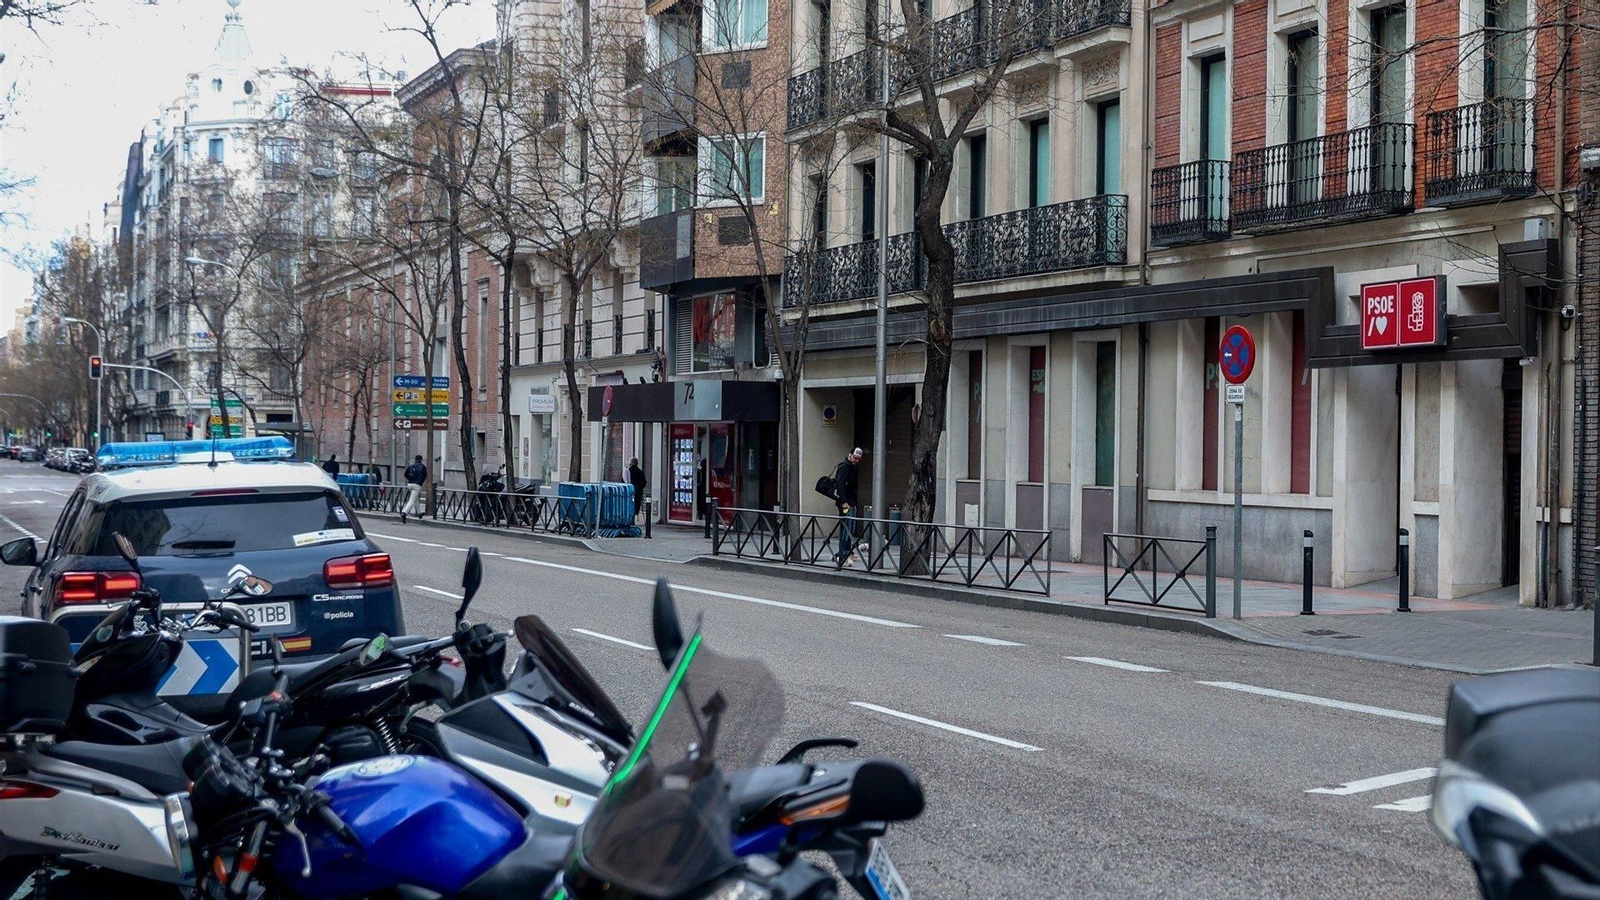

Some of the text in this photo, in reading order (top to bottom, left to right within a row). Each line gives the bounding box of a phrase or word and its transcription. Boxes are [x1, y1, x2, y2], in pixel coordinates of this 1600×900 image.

[1367, 295, 1395, 315] PSOE
[684, 382, 695, 405] 72
[313, 593, 330, 602] C5
[323, 611, 354, 621] @policia
